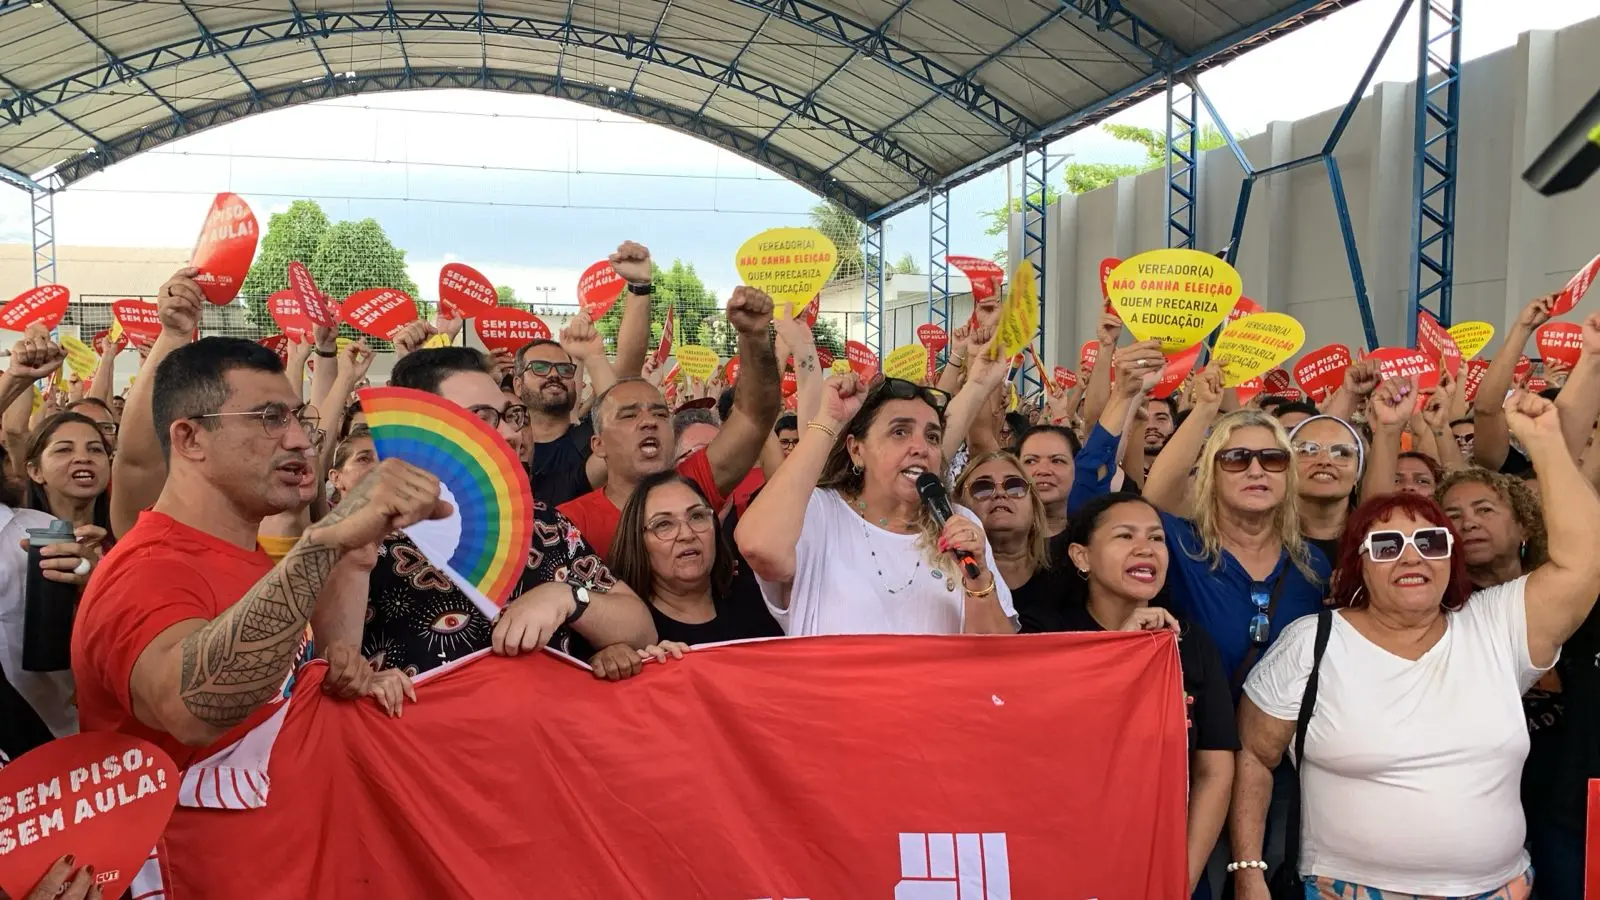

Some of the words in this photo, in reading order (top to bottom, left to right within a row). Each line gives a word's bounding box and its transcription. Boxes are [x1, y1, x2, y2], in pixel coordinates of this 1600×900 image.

[758, 240, 815, 252] VEREADOR(A)
[740, 255, 758, 266] NÃO
[762, 255, 790, 265] GANHA
[794, 252, 831, 265] ELEIÇÃO
[596, 266, 613, 280] PIS
[747, 271, 772, 281] QUEM
[774, 268, 821, 281] PRECARIZA
[1138, 263, 1214, 278] VEREADOR(A)
[442, 277, 463, 292] SEM
[463, 287, 494, 307] AULA!
[446, 270, 468, 283] SEM
[468, 280, 495, 298] PISO,
[766, 281, 813, 295] EDUCAÇÃO!
[1112, 278, 1136, 290] NÃO
[1140, 280, 1180, 291] GANHA
[1184, 282, 1233, 297] ELEIÇÃO
[2, 303, 25, 321] SEM
[25, 287, 57, 305] PISO,
[6, 308, 30, 326] SEM
[31, 287, 65, 309] AULA!
[119, 306, 141, 315] SEM
[142, 308, 159, 316] PIS
[275, 307, 301, 315] SEM
[350, 303, 373, 320] SEM
[370, 291, 397, 306] PISO,
[358, 310, 382, 328] SEM
[380, 295, 408, 314] AULA!
[1120, 296, 1153, 308] QUEM
[1156, 298, 1218, 313] PRECARIZA
[120, 314, 141, 322] SEM
[143, 316, 162, 324] AUL
[482, 320, 507, 329] SEM
[509, 320, 543, 330] PISO,
[1130, 313, 1138, 323] A
[1142, 313, 1204, 329] EDUCAÇÃO!
[482, 330, 507, 338] SEM
[509, 331, 546, 339] AULA!
[1541, 338, 1562, 347] SEM
[1543, 331, 1565, 339] SEM
[1566, 332, 1584, 341] PIS
[1236, 342, 1277, 361] PRECARIZA
[1261, 337, 1295, 352] ELEIÇÃO
[1298, 363, 1316, 377] SEM
[1317, 353, 1344, 367] PISO,
[1300, 371, 1318, 384] SEM
[1318, 358, 1348, 375] AULA!
[1380, 360, 1396, 371] EM
[1396, 355, 1428, 367] PISO,
[1381, 370, 1398, 381] EM
[1400, 363, 1436, 377] AULA!
[0, 776, 62, 823] SEM
[69, 748, 154, 793] PISO,
[0, 807, 65, 855] SEM
[74, 768, 167, 824] AULA!
[97, 871, 118, 882] CUT
